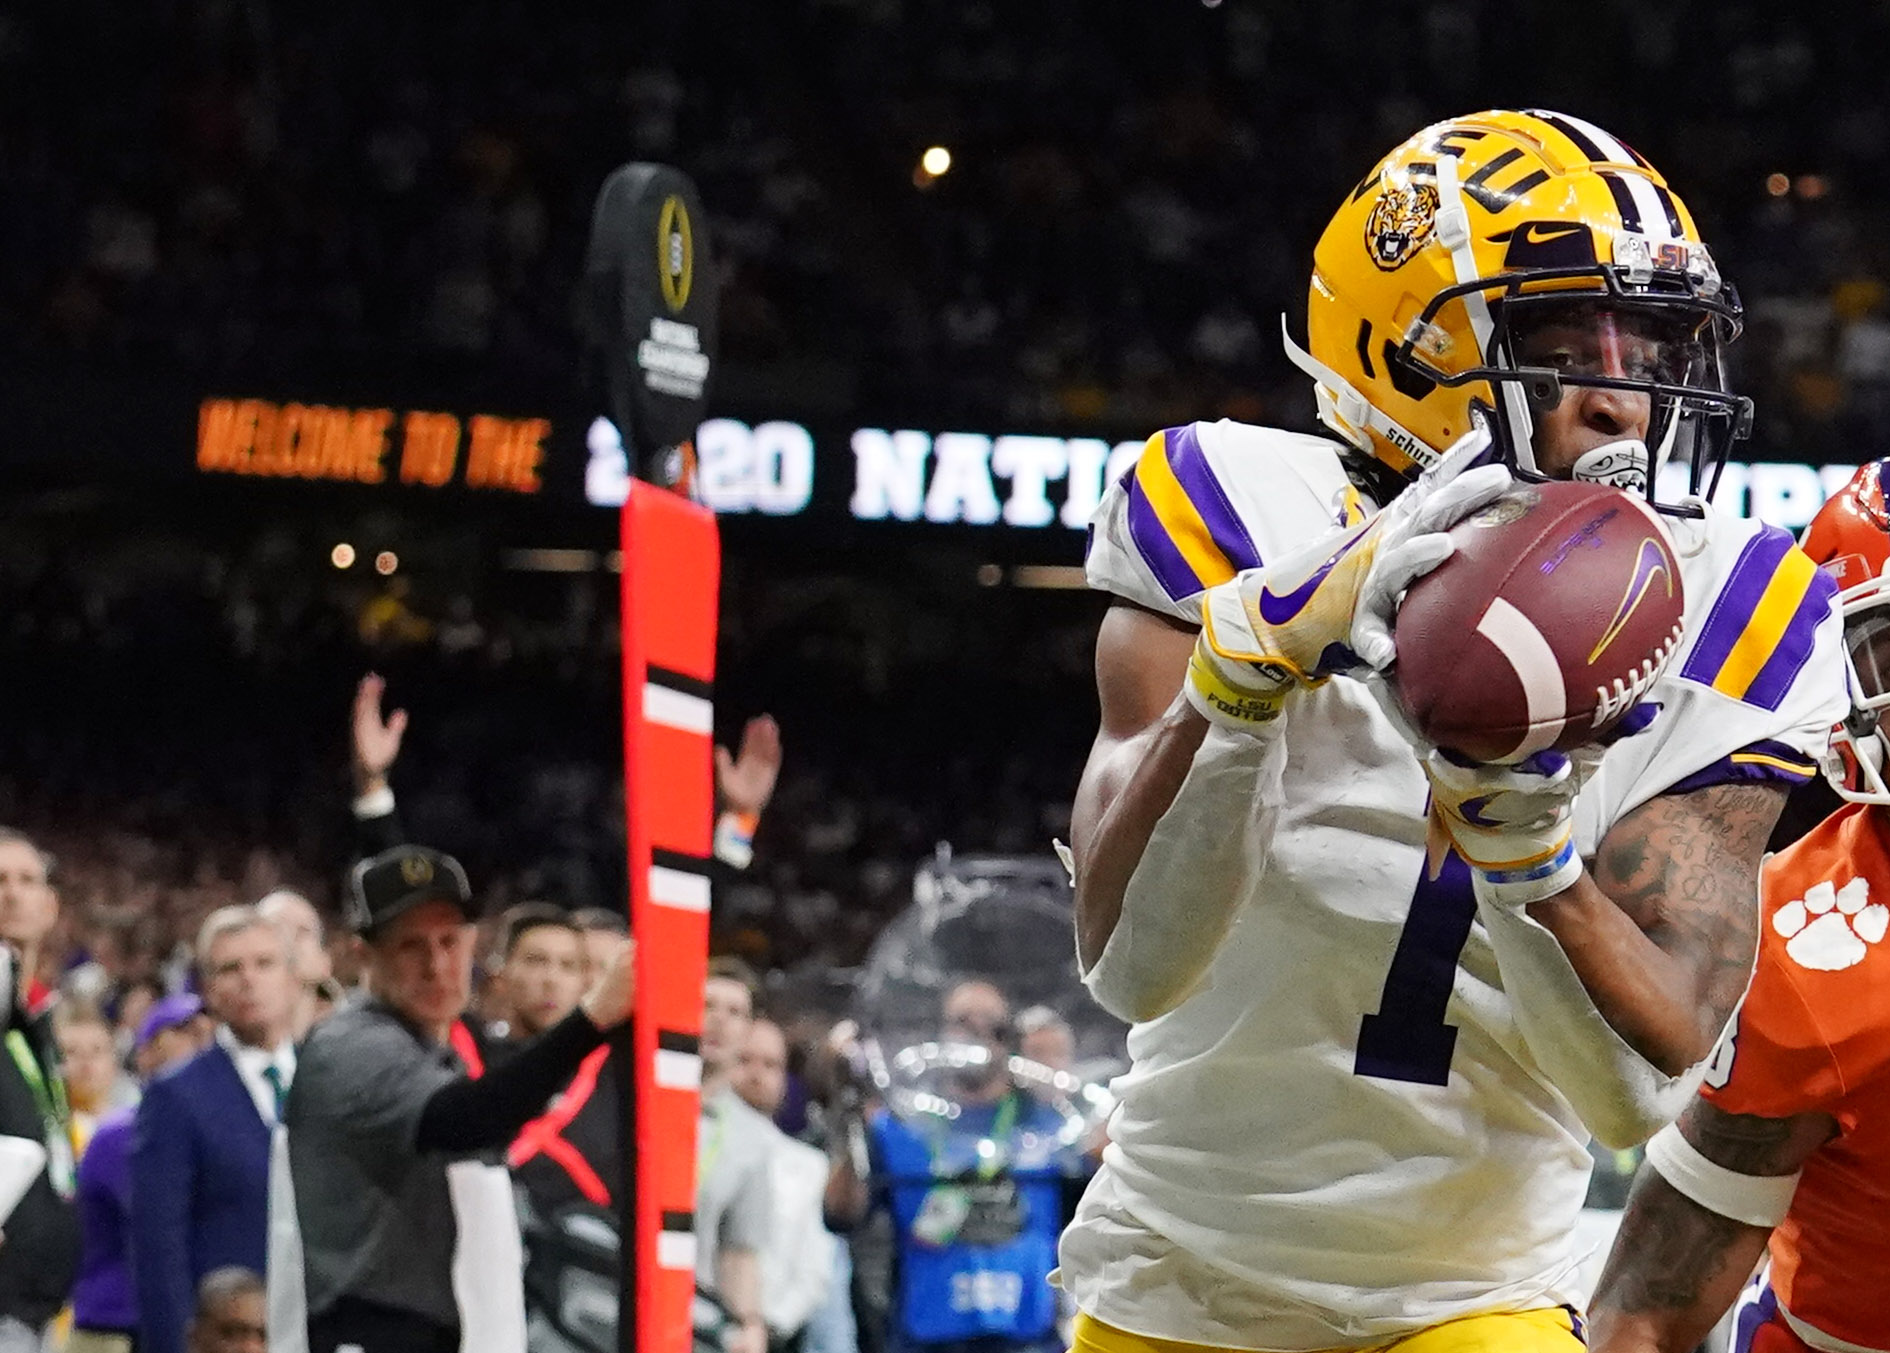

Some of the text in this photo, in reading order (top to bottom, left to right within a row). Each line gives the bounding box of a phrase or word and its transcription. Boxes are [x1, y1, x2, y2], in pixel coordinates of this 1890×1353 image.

[196, 397, 552, 494] WELCOME TO THE
[1386, 427, 1440, 466] schut
